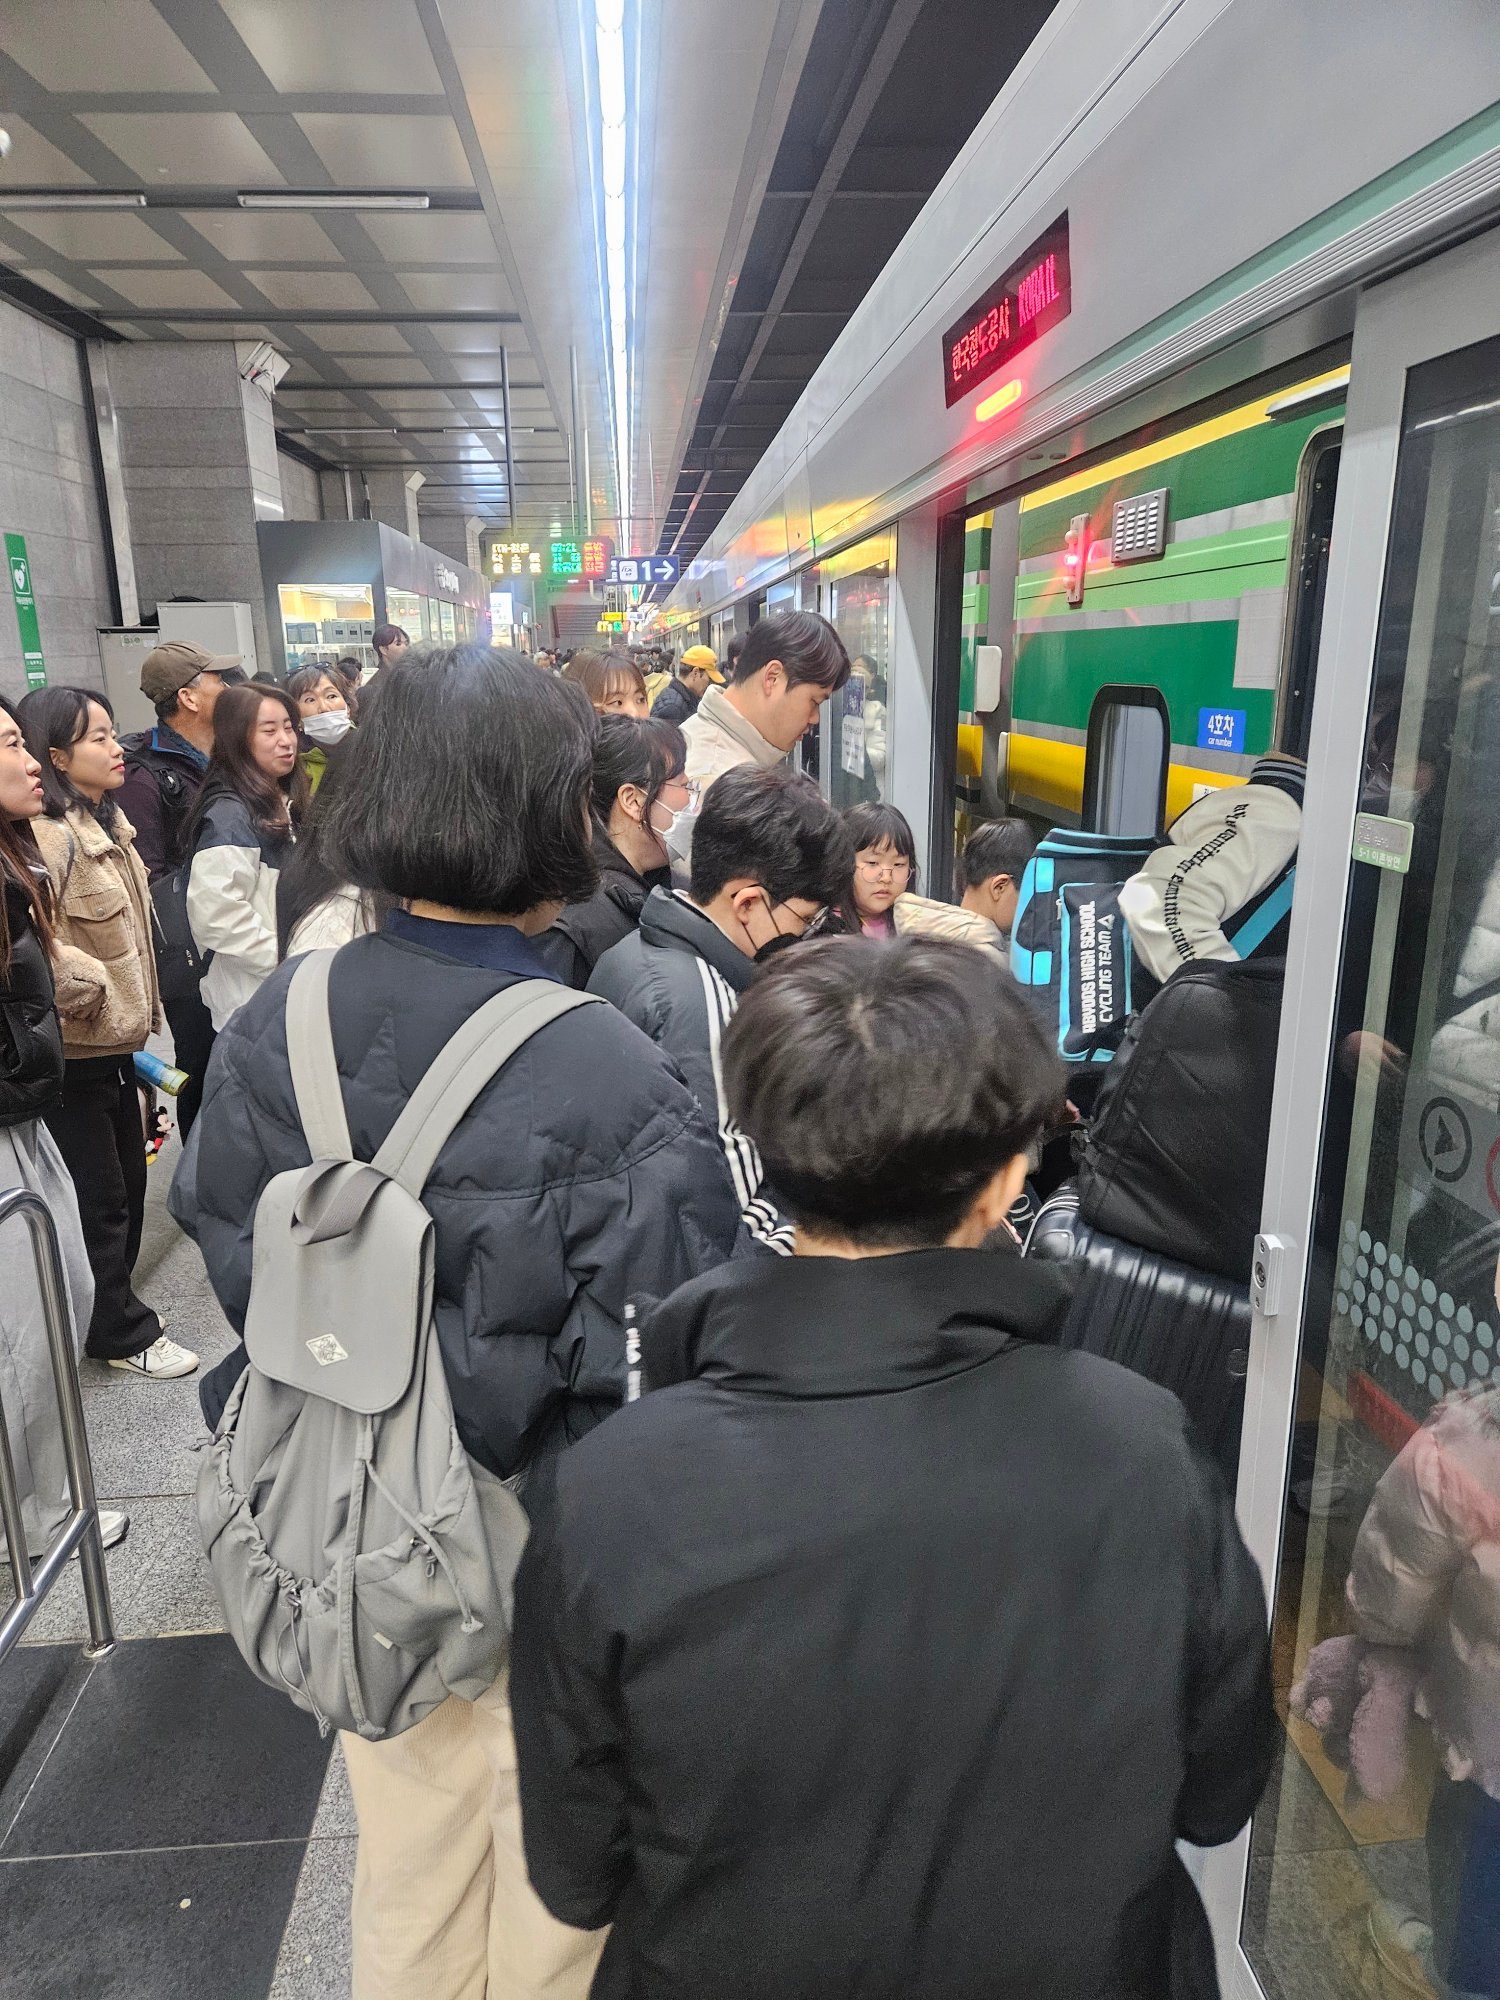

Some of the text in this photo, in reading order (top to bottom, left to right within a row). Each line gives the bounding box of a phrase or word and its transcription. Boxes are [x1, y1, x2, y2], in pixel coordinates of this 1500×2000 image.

[952, 254, 1060, 382] 한국철도공사 KORAIL
[641, 561, 651, 581] 1
[1208, 714, 1235, 738] 4호차
[1215, 738, 1232, 747] number
[1371, 850, 1401, 869] 이촌방면
[1079, 900, 1096, 1034] ABYDOS HIGH SCHOOL
[1098, 930, 1114, 1023] CYCLING TEAM
